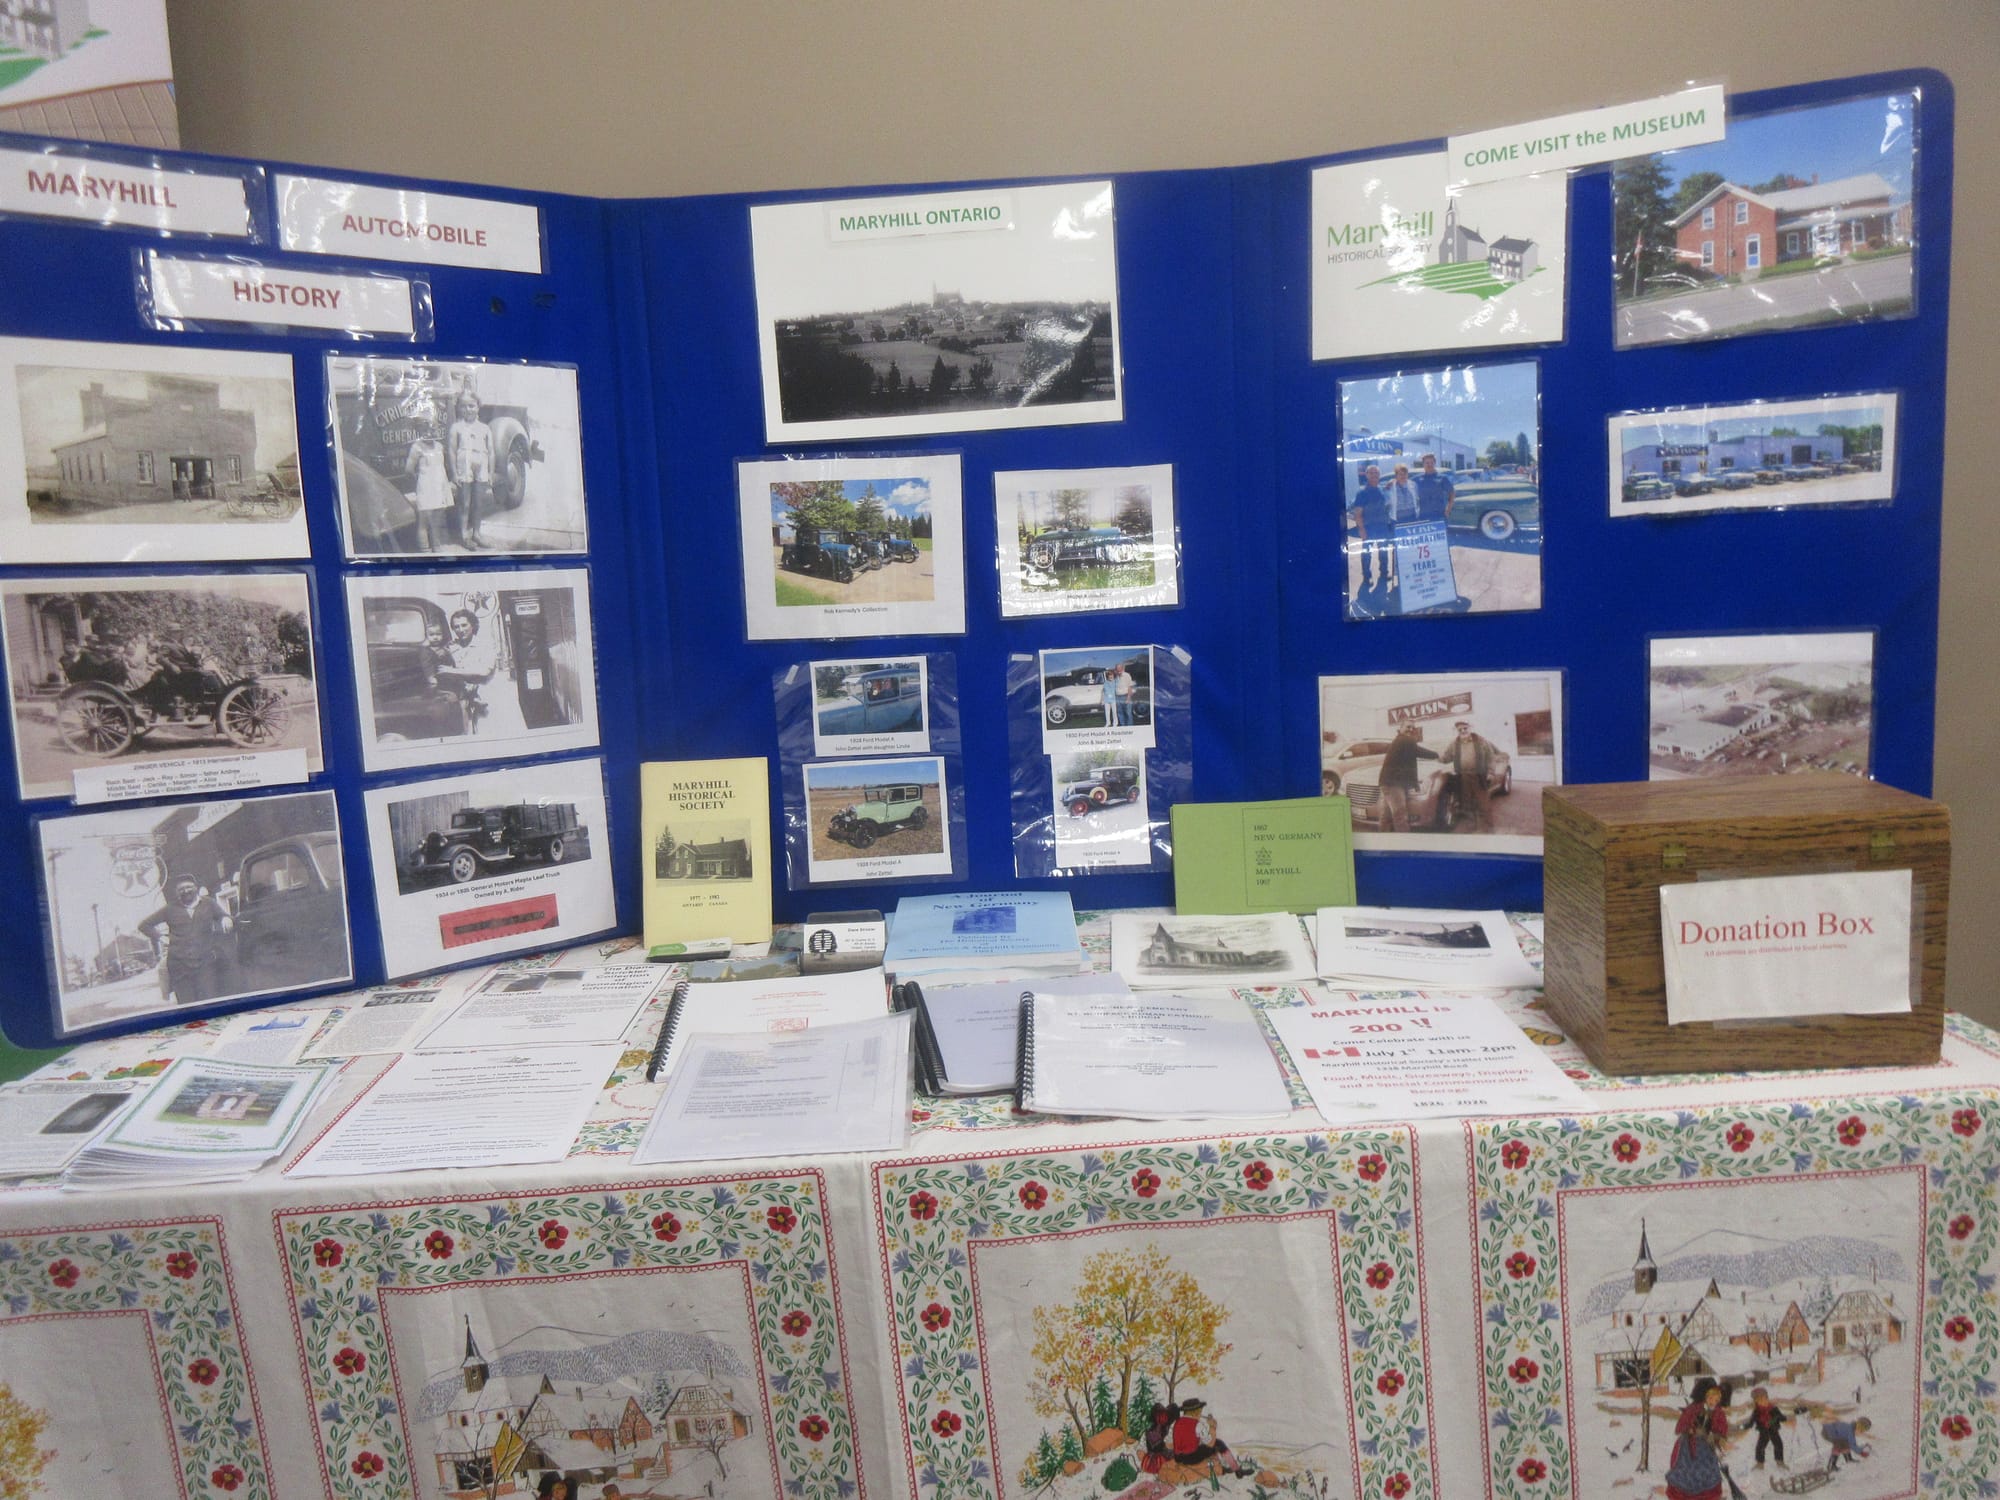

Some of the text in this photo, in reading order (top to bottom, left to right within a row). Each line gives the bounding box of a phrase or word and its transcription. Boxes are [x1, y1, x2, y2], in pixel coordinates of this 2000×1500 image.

[1464, 109, 1706, 168] COME VISIT the MUSEUM
[28, 169, 487, 247] MARYHILL AUTOMOBILE
[839, 206, 1001, 231] MARYHILL ONTARIO
[1327, 242, 1433, 264] HISTORICAL SOETY
[233, 280, 341, 310] HISTORY
[1417, 545, 1430, 559] 75
[672, 780, 732, 791] MARYHILL
[669, 790, 736, 801] HISTORICAL
[679, 800, 726, 811] SOCIETY
[1253, 832, 1323, 841] NEW GERMANY
[1255, 867, 1302, 876] MARYHILL
[471, 884, 493, 892] General
[495, 889, 503, 897] by
[1680, 911, 1875, 945] Donation Box
[1310, 1005, 1428, 1019] MARYHILL
[1348, 1023, 1402, 1034] 200
[1365, 1050, 1395, 1058] July
[1480, 1045, 1517, 1054] 2pm
